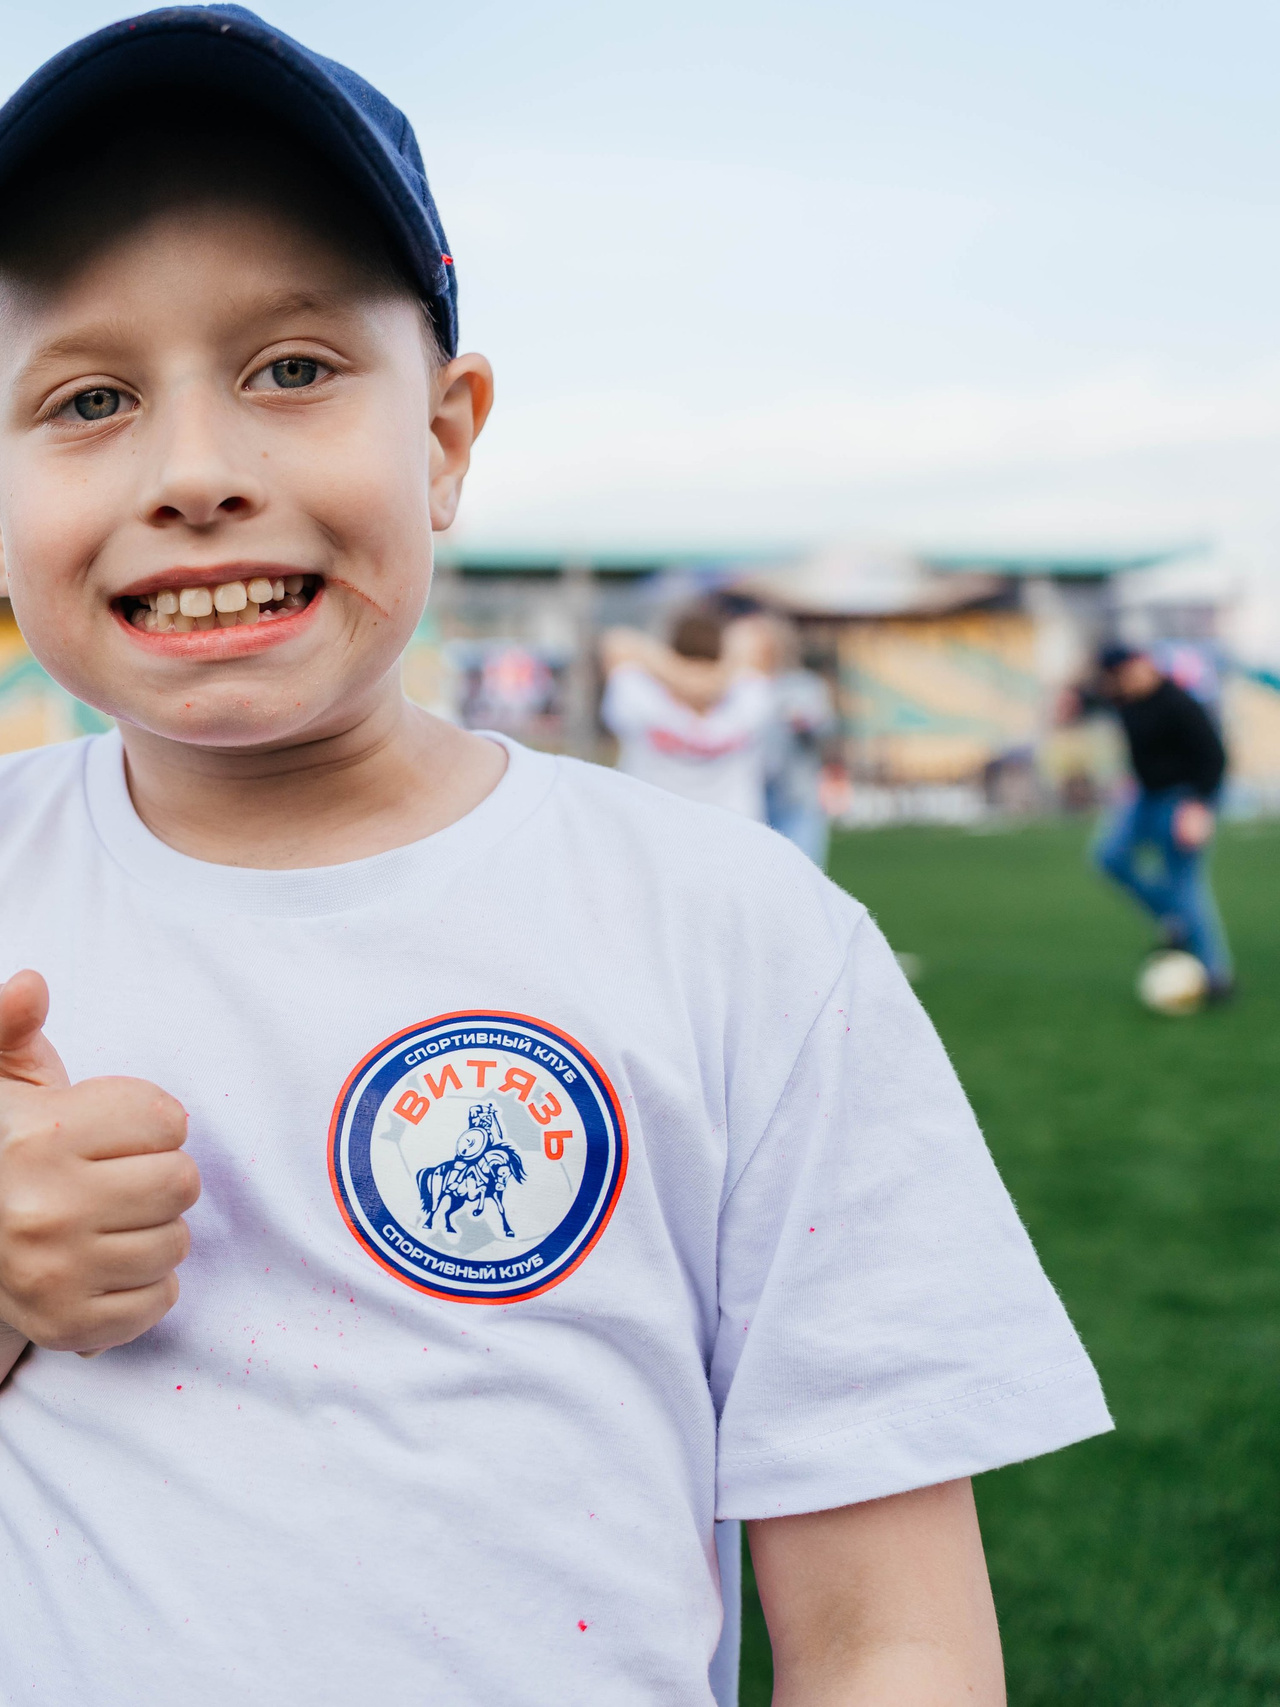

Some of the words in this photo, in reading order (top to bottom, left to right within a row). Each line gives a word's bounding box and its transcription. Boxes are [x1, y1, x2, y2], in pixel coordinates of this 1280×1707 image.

[404, 1032, 532, 1066] СПОРТИВНЫЙ
[533, 1045, 577, 1085] КЛУБ
[392, 1059, 573, 1160] ВИТЯЗЬ
[382, 1223, 496, 1280] СПОРТИВНЫЙ
[499, 1253, 544, 1279] КЛУБ
